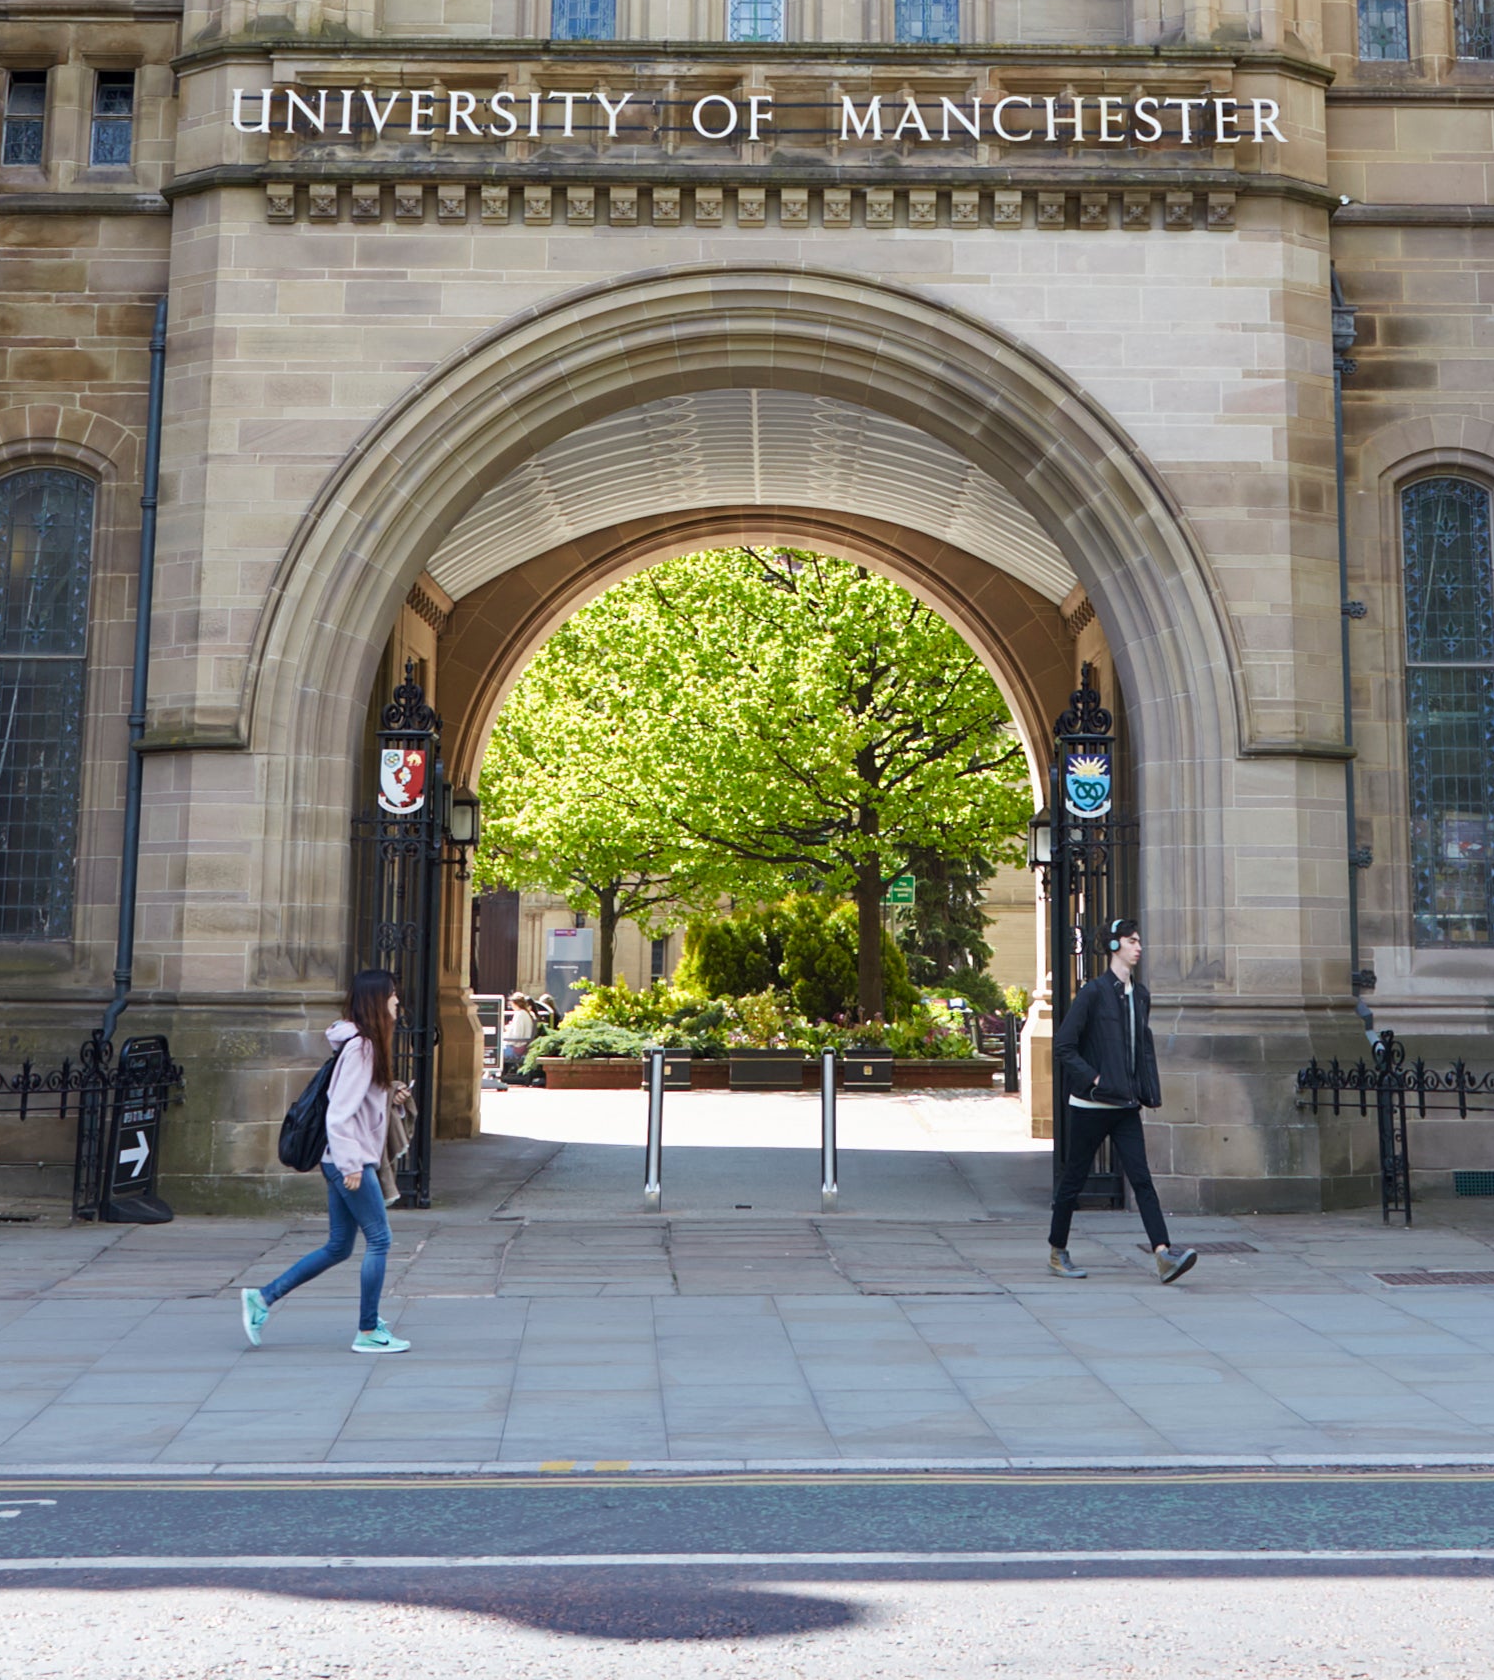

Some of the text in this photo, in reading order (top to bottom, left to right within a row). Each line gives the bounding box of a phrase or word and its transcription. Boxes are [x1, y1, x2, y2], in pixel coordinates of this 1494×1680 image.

[231, 87, 1290, 144] UNIVERSITY OF MANCHESTER
